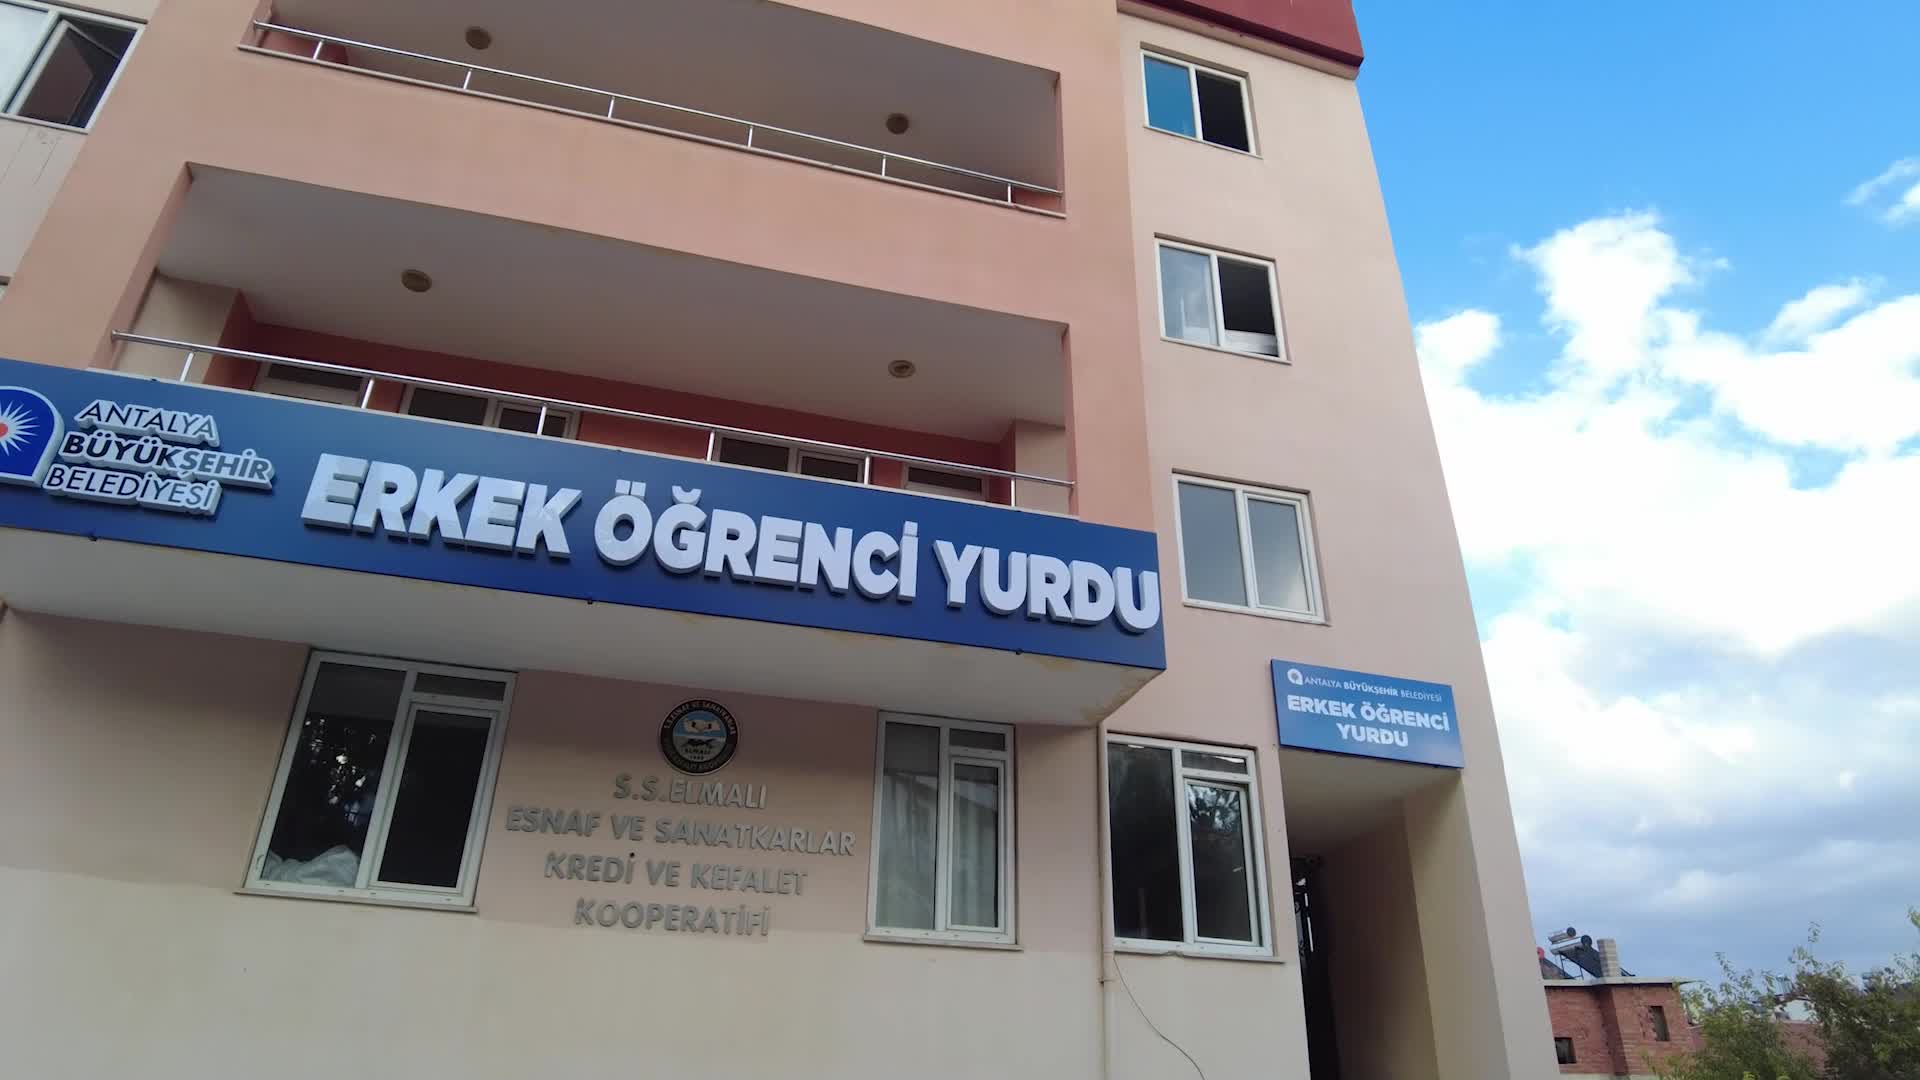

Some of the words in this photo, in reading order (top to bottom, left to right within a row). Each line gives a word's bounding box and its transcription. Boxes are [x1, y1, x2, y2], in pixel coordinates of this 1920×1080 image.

[79, 402, 215, 440] ANTALYA
[62, 431, 271, 481] BÜYÜKŞEHİR
[46, 466, 217, 508] BELEDİYESİ
[301, 453, 583, 558] ERKEK
[594, 479, 919, 602] ÖĞRENCİ
[932, 539, 1161, 634] YURDU
[1304, 677, 1342, 689] ANTALYA
[1343, 680, 1399, 696] BÜYÜKŞEHİR
[1400, 690, 1442, 702] BELEDİYESİ
[1287, 694, 1357, 719] ERKEK
[1360, 701, 1450, 731] ÖĞRENCİ
[1336, 722, 1409, 747] YURDU
[505, 805, 600, 837] ESNAF
[611, 813, 646, 841] VE
[654, 817, 856, 857] SANATKARLAR
[544, 851, 635, 884] KREDİ
[645, 860, 681, 888] VE
[690, 863, 808, 896] KEFALET
[573, 898, 770, 937] KOOPERATİFİ
